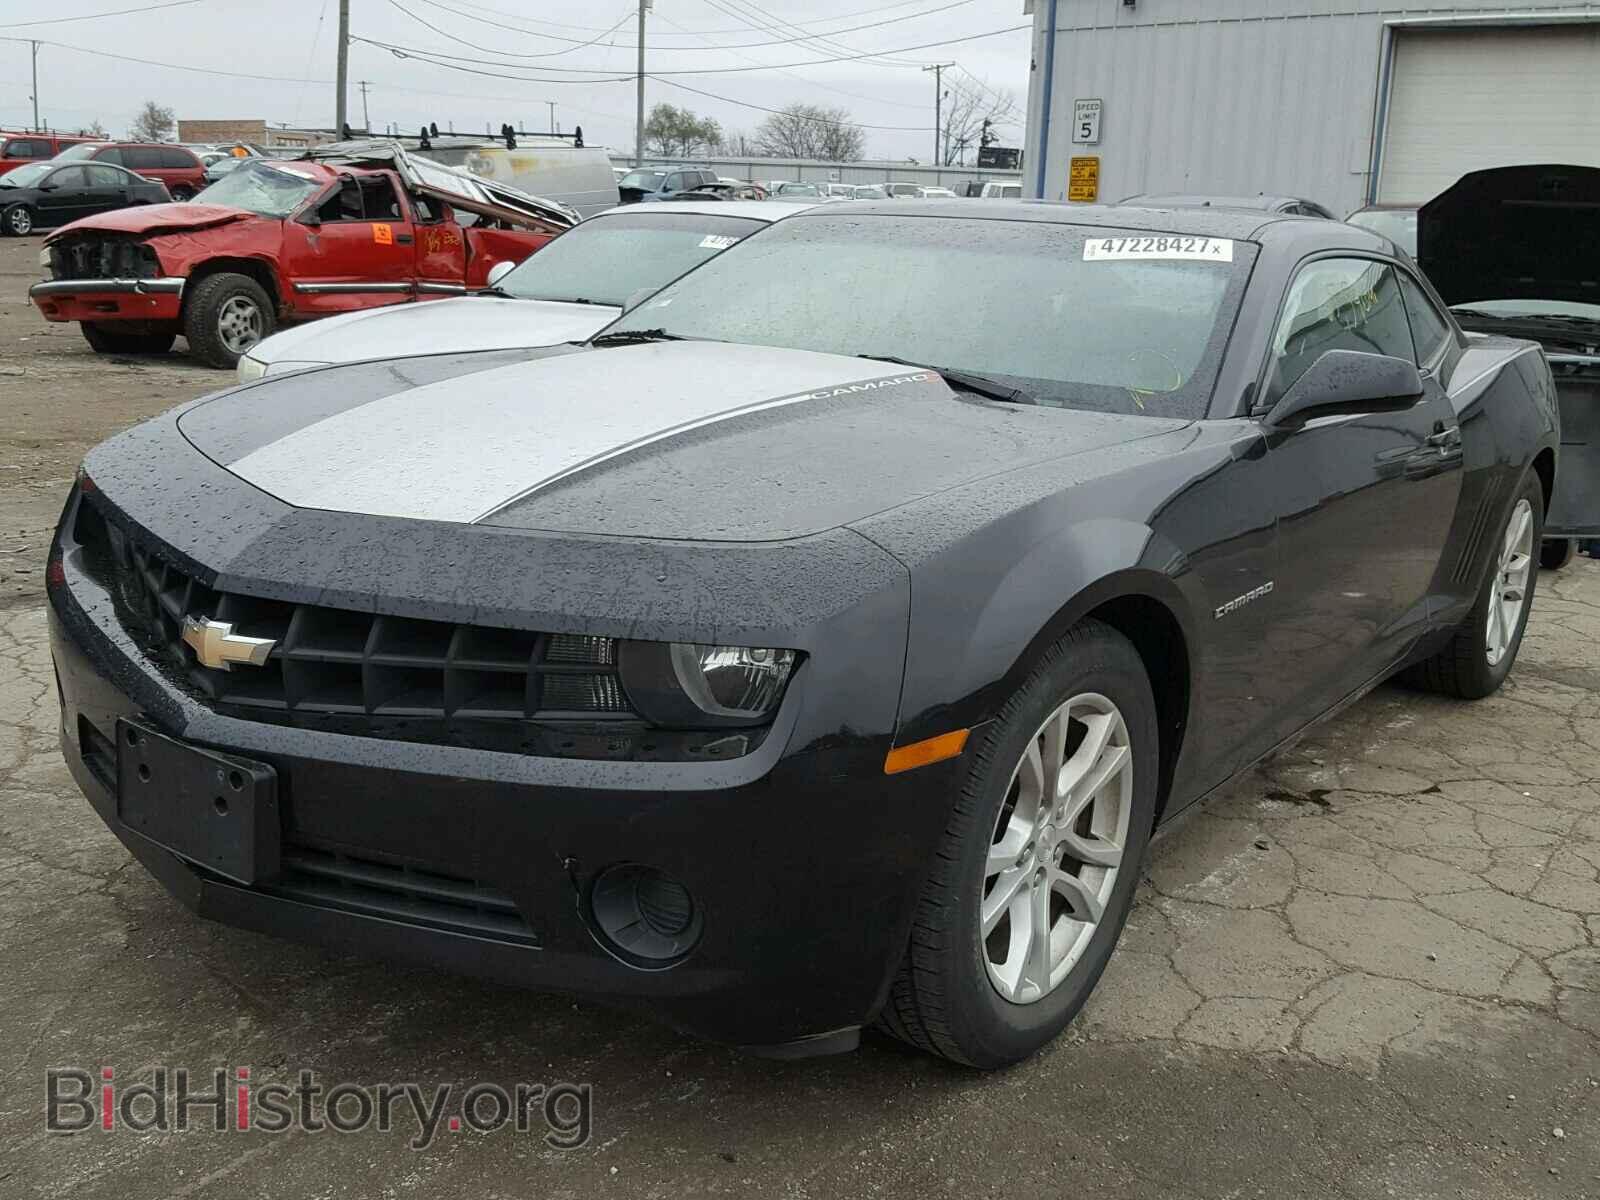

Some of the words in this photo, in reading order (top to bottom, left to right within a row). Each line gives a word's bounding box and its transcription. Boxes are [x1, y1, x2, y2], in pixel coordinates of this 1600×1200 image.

[1077, 103, 1099, 111] SPEED
[1078, 112, 1096, 120] LIMIT
[1081, 122, 1092, 138] 5
[810, 373, 929, 400] CAMARO
[1215, 580, 1274, 620] CAMARO
